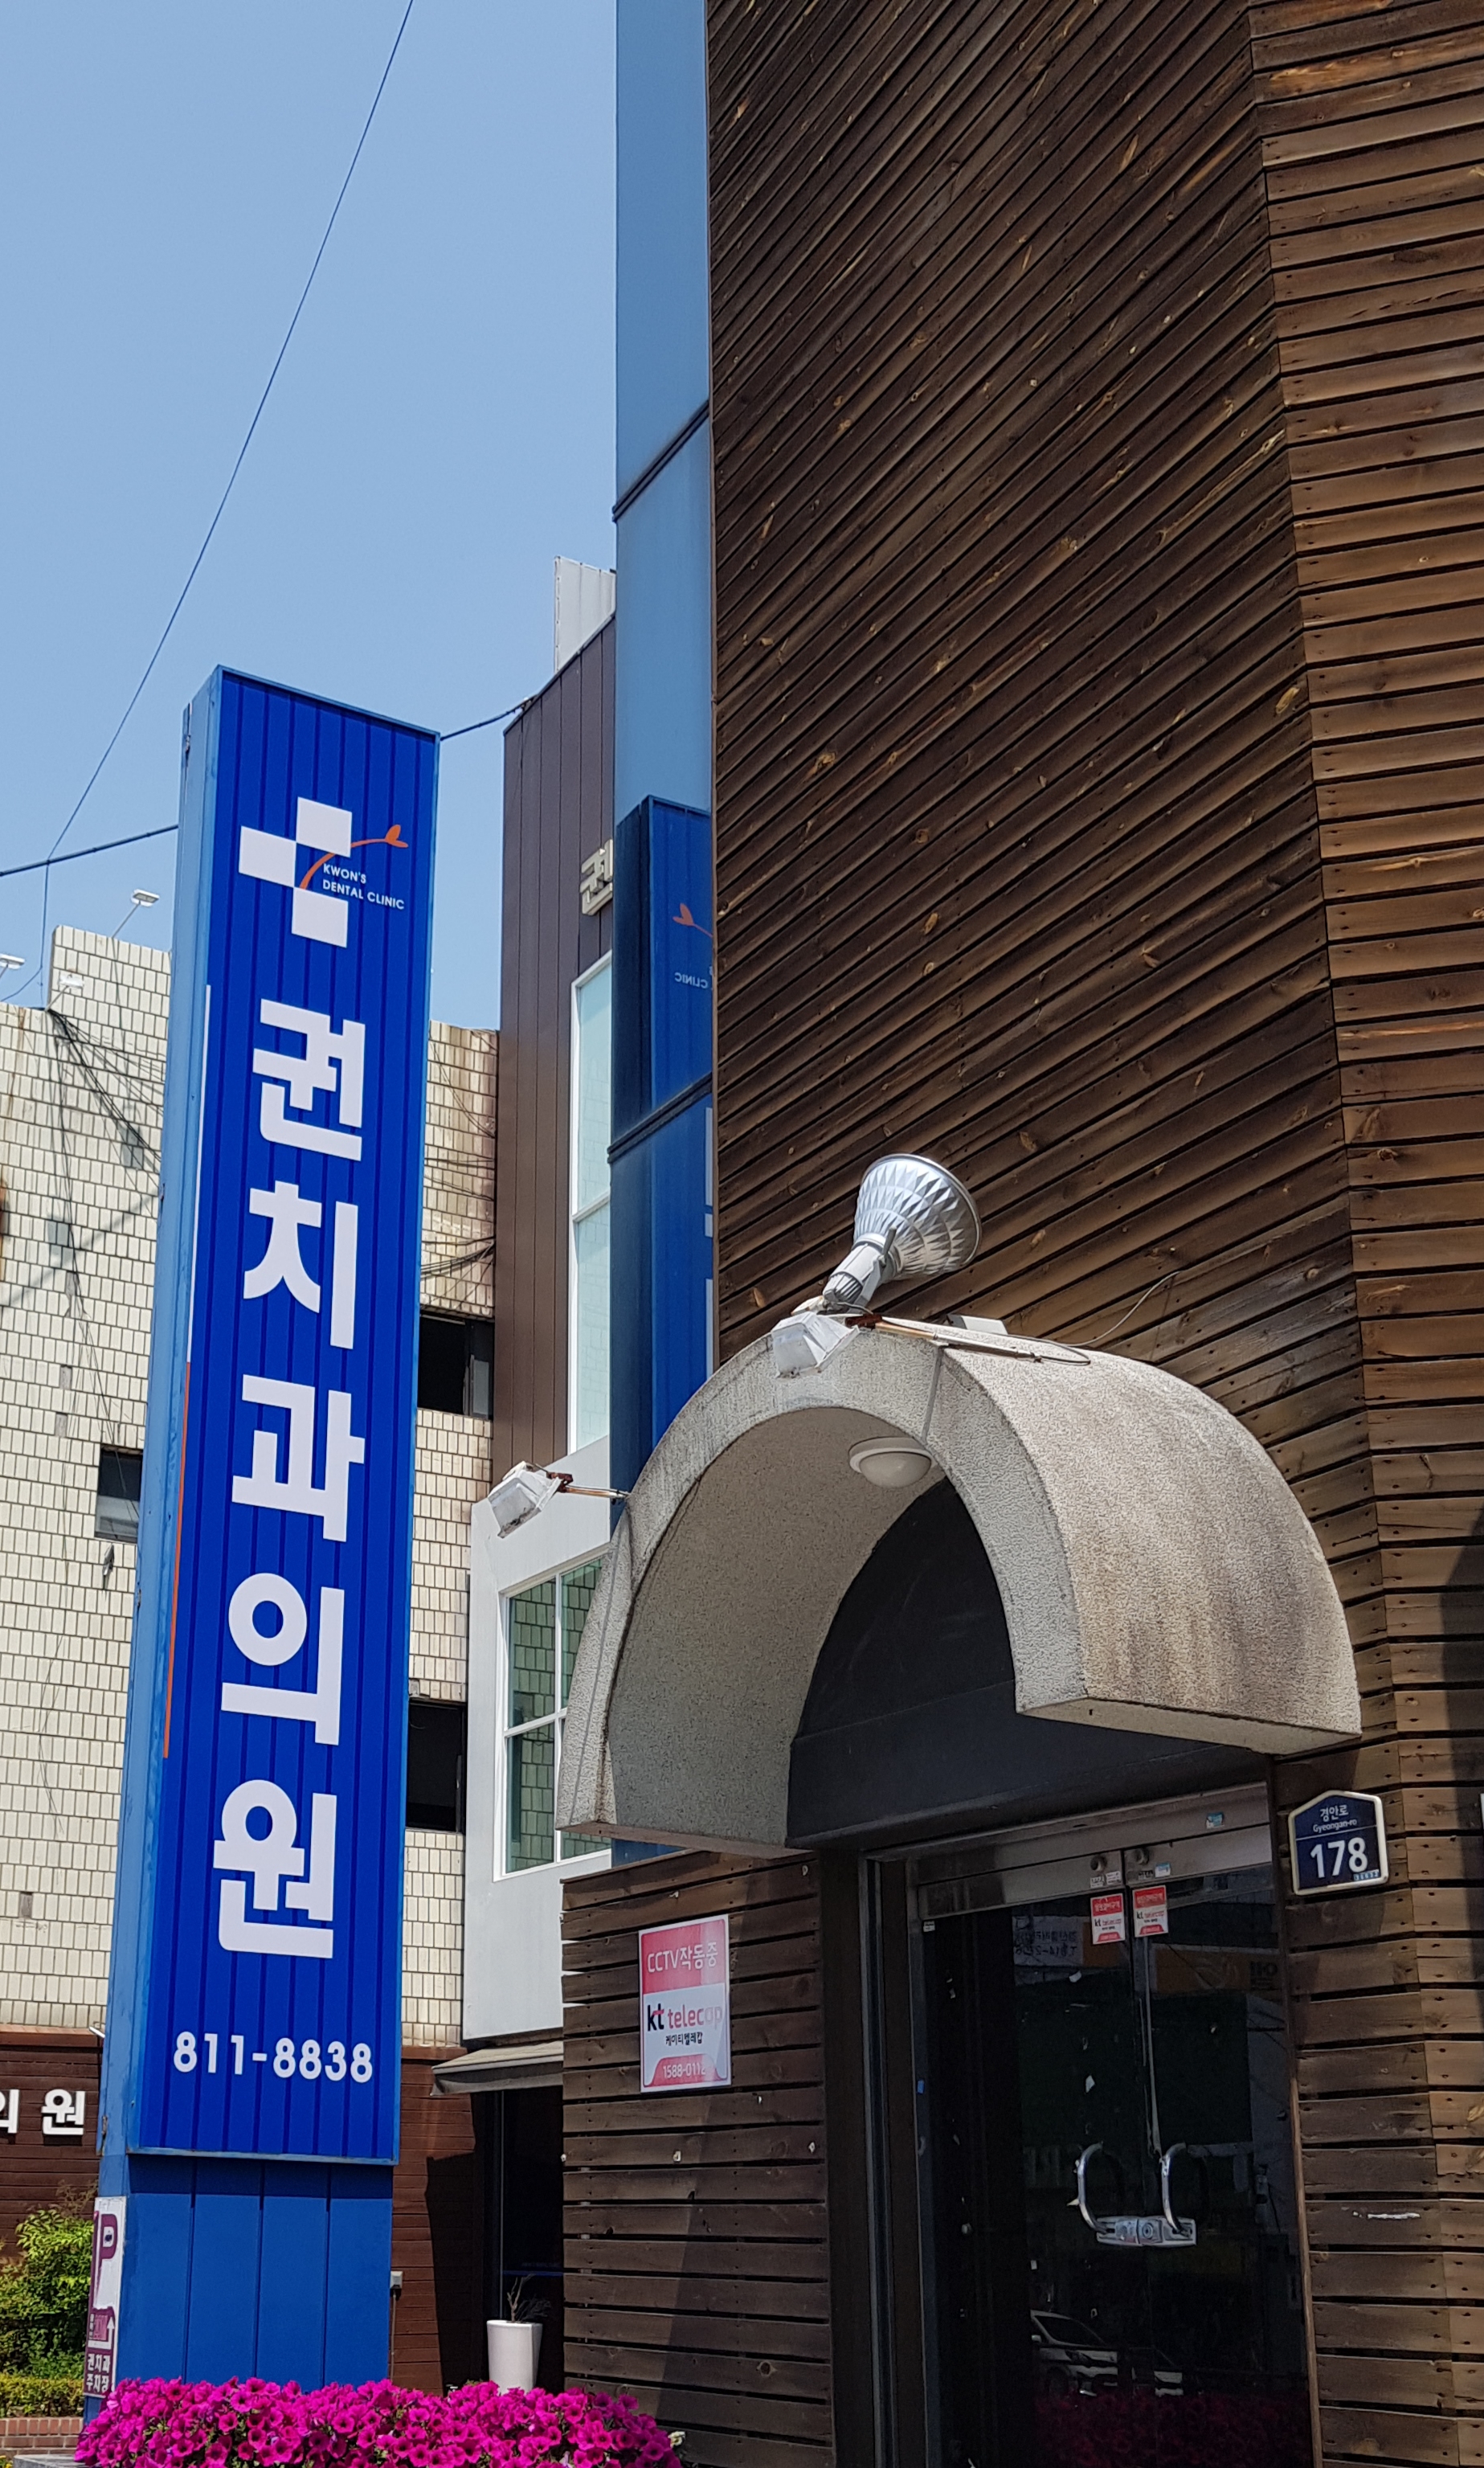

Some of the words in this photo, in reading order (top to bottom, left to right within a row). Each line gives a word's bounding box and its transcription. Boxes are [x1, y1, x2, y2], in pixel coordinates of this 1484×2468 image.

[323, 863, 366, 884] KWON'S
[323, 879, 364, 899] DENTAL
[367, 892, 404, 910] CLINIC
[213, 998, 366, 1958] 권치과의원
[1313, 1819, 1357, 1832] Gyeongan-ro
[1320, 1805, 1348, 1822] 경안로
[1310, 1837, 1367, 1879] 178
[647, 1942, 718, 1974] CCTV작동중
[647, 2003, 664, 2032] kt
[667, 2003, 723, 2031] telecop
[173, 2032, 374, 2083] 811-8838
